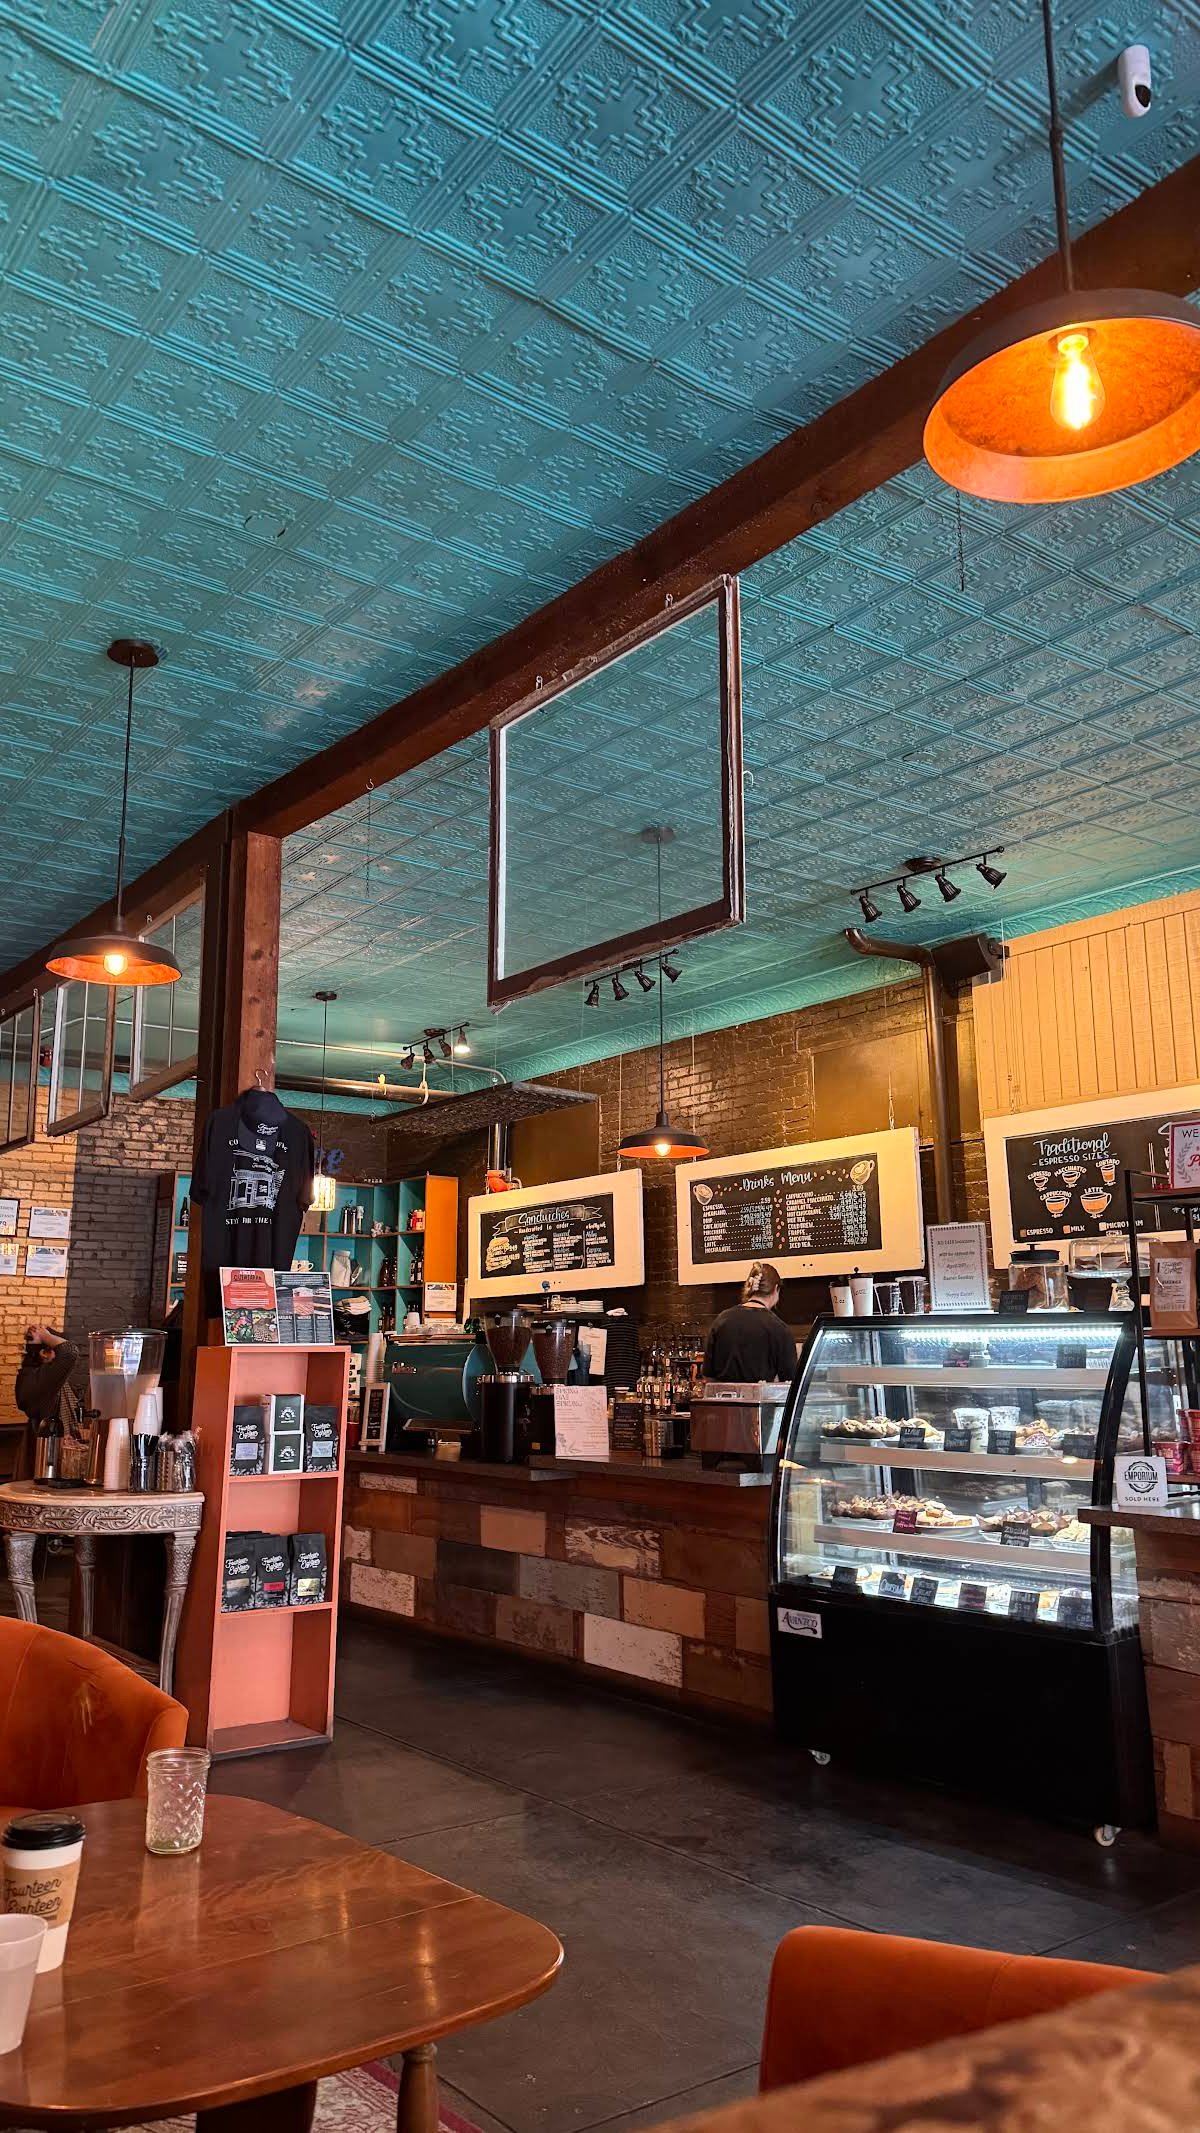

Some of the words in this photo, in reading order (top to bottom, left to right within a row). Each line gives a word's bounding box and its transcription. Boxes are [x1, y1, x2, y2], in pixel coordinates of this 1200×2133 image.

[1033, 1131, 1111, 1156] Traditional
[1039, 1154, 1080, 1166] ESPRESSO
[1082, 1150, 1110, 1161] SIZES
[742, 1175, 775, 1191] Drinks
[781, 1171, 813, 1186] Menu
[518, 1207, 570, 1227] Sandwiches
[1026, 1227, 1053, 1236] ESPRESSO
[1070, 1224, 1085, 1232] MILK
[1106, 1221, 1126, 1230] MICRO
[1124, 1471, 1159, 1481] EMPORIUM
[4, 1878, 62, 1898] Fourteen
